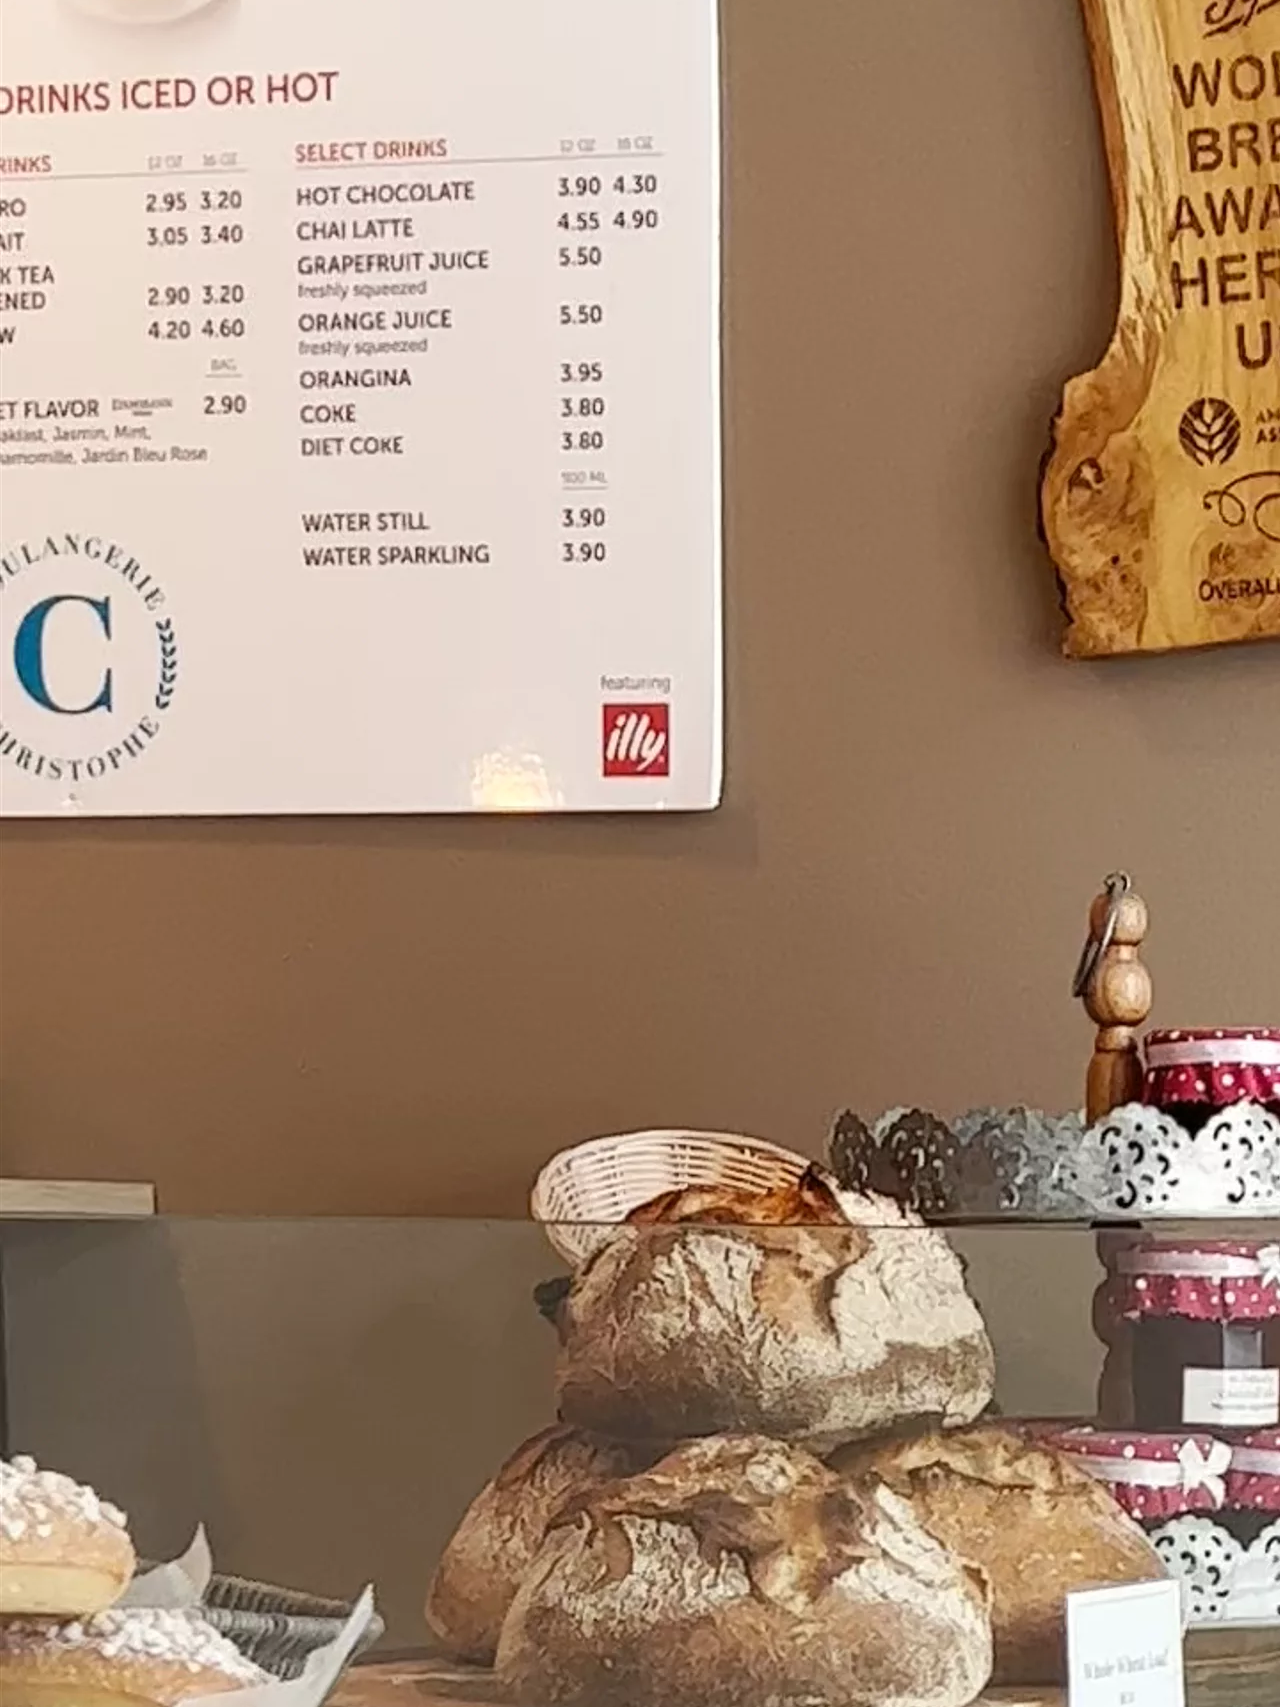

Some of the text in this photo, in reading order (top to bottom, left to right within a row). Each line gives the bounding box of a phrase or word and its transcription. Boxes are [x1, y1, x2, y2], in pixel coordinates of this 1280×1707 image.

[121, 79, 196, 109] ICED
[207, 76, 255, 105] OR
[267, 71, 339, 104] HOT
[295, 139, 447, 163] SELECT DRINKS
[146, 191, 187, 212] 2.95
[200, 190, 242, 210] 3.20
[296, 174, 657, 206] HOT CHOCOLATE 3.90 4.30
[147, 227, 188, 247] 3.05
[200, 225, 243, 244] 3.40
[296, 209, 658, 241] CHAI LATTE 4.55 4.90
[297, 246, 602, 275] GRAPEFRUIT JUICE 5.50
[18, 265, 54, 284] TEA
[148, 287, 190, 306] 2.90
[202, 285, 244, 304] 3.20
[353, 280, 427, 299] squeezed
[148, 320, 191, 339] 4.20
[201, 318, 245, 338] 4.60
[298, 305, 603, 332] ORANGE JUICE 5.50
[354, 338, 428, 356] squeezed
[299, 362, 603, 389] ORANGINA 3.95
[24, 399, 100, 419] FLAVOR
[204, 395, 247, 414] 2.90
[300, 397, 605, 424] COKE 3.80
[301, 431, 604, 456] DIET COKE 3.80
[301, 508, 605, 533] WATER STILL 3.90
[303, 542, 606, 566] WATER SPARKLING 3.90
[0, 533, 165, 611] ULANGERIE
[13, 593, 113, 715] C
[0, 714, 160, 781] HRISTOPHE
[606, 712, 666, 772] illy
